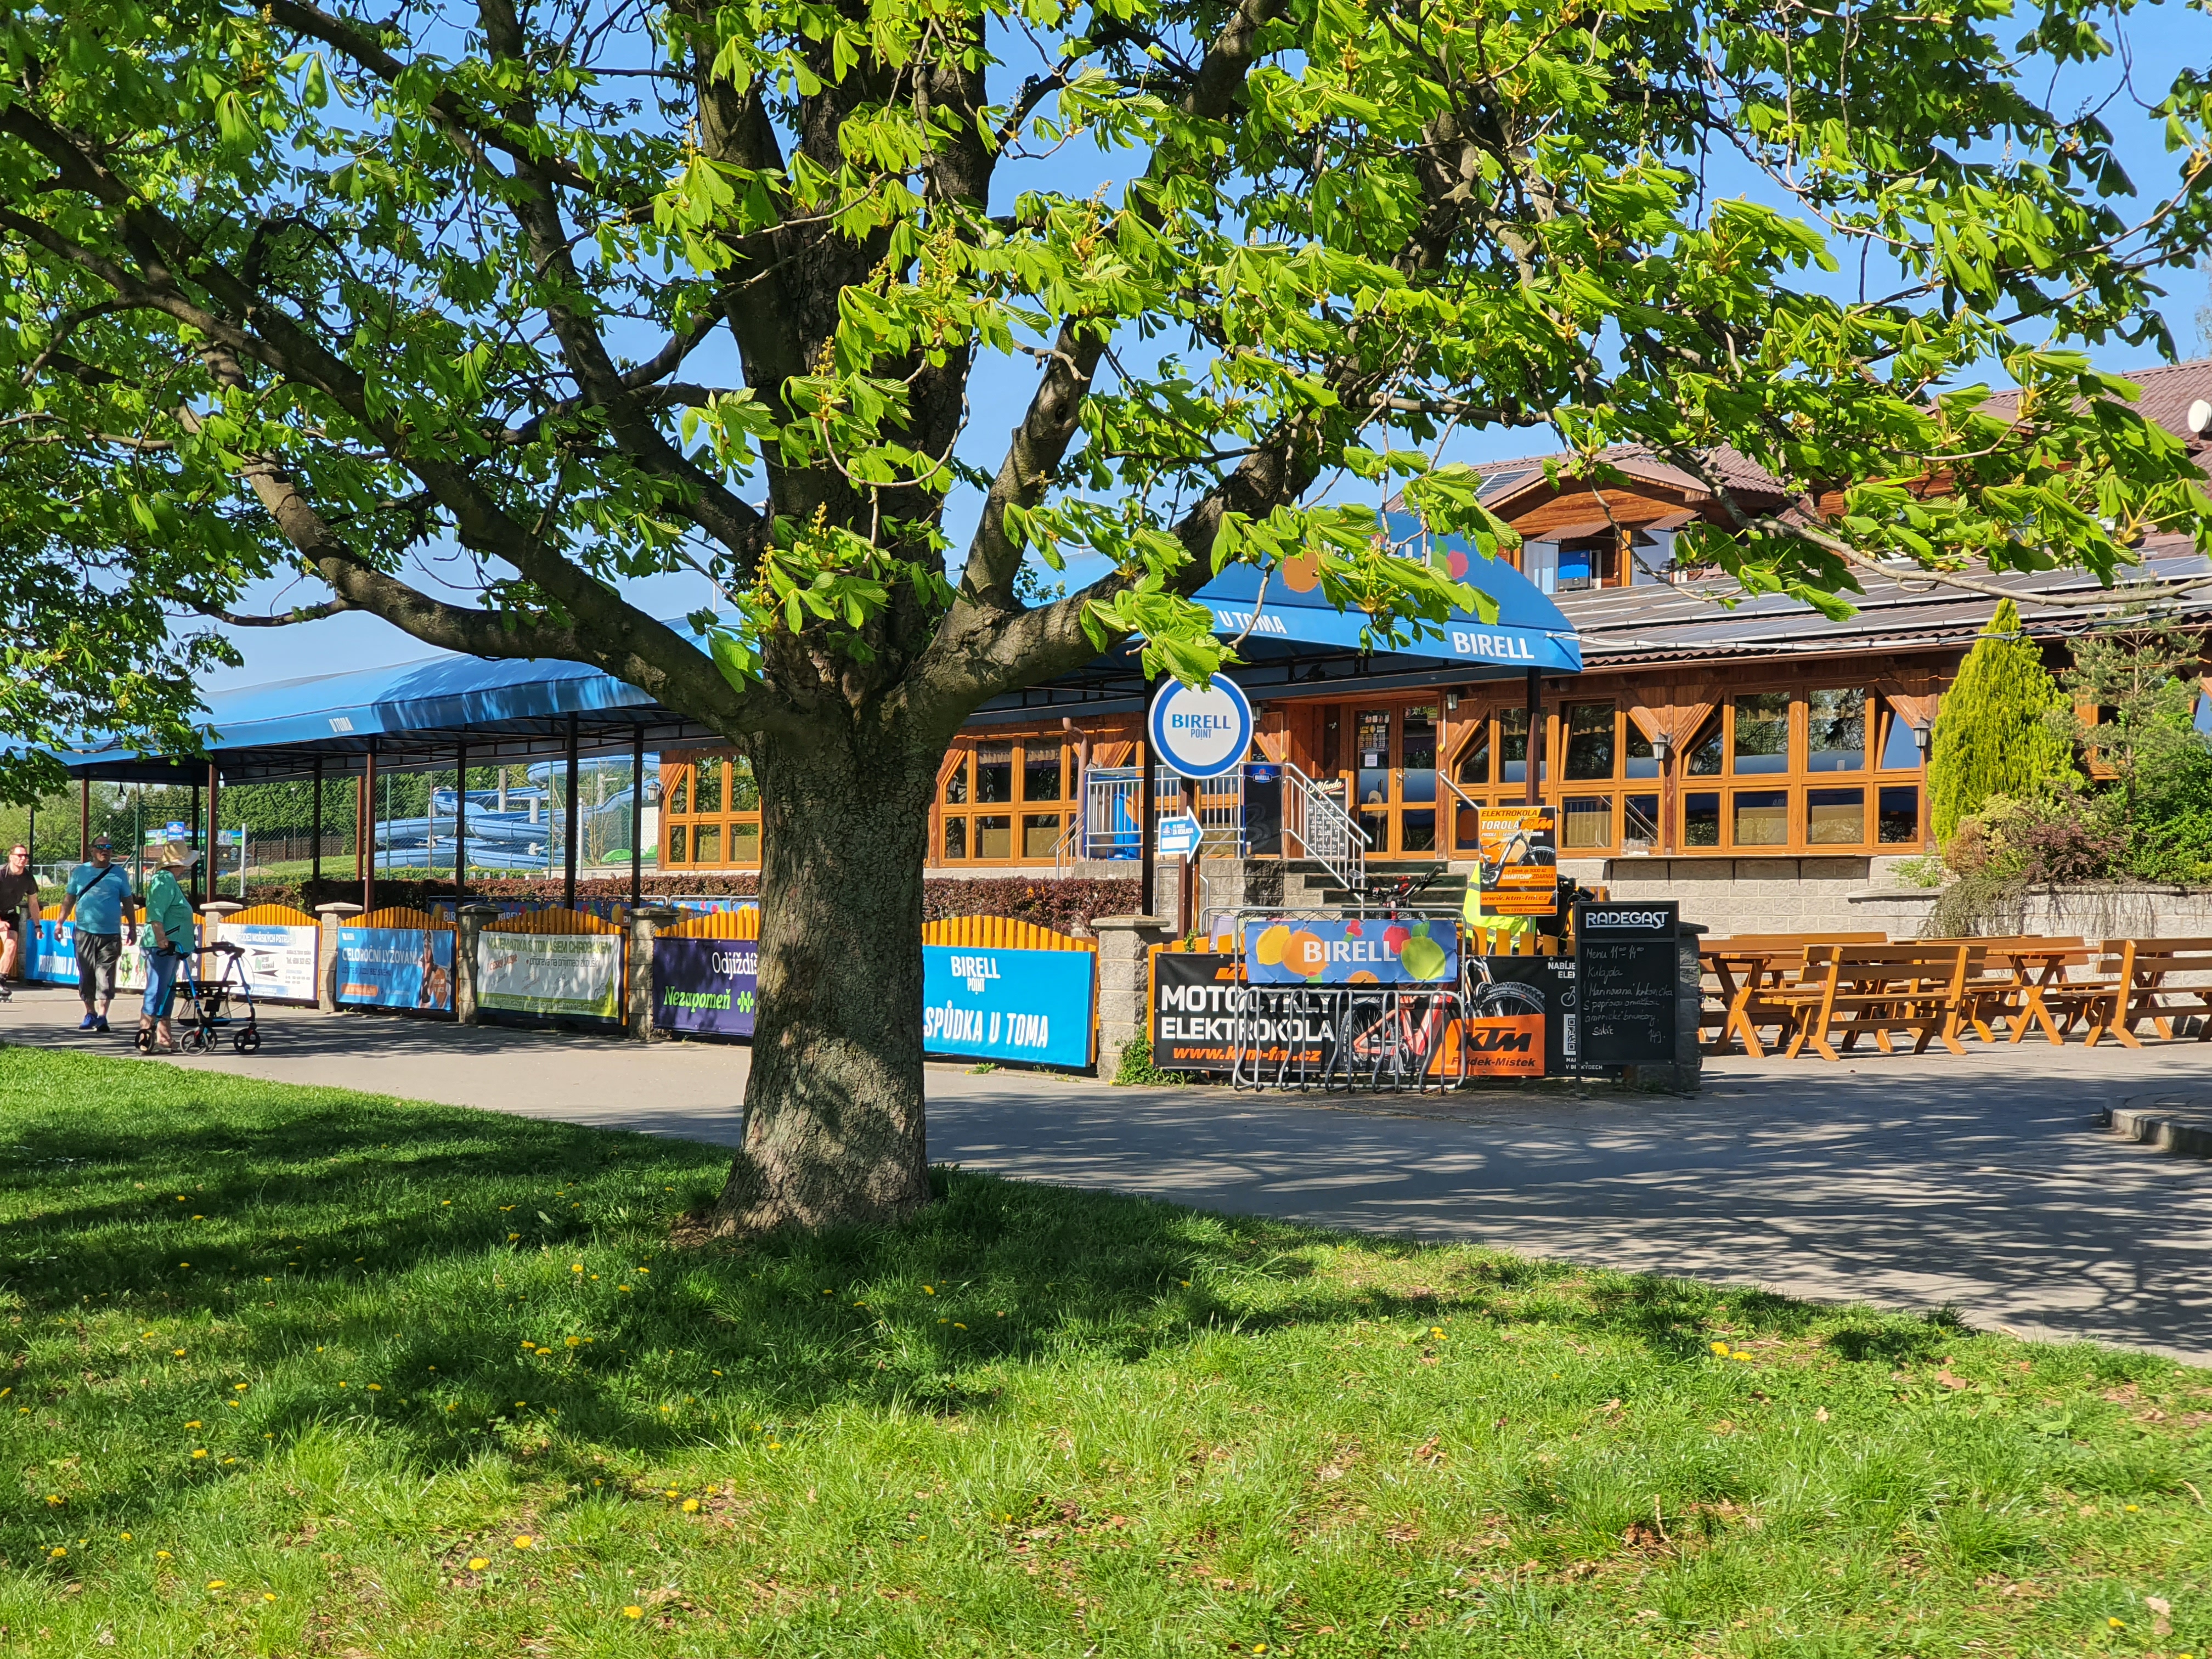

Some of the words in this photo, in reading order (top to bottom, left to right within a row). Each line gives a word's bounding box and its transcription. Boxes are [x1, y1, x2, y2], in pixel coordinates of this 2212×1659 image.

[1217, 610, 1234, 628] U
[1232, 612, 1288, 634] TOMA
[1452, 631, 1535, 659] BIRELL
[1172, 714, 1232, 729] BIRELL
[1190, 729, 1212, 740] POINT
[1481, 820, 1519, 830] TOROLA
[1520, 817, 1554, 830] KTM
[1586, 911, 1669, 929] RADEGAST
[342, 945, 381, 962] CELOROČNÍ
[382, 946, 417, 964] LYŽOVÁNÍ
[1304, 941, 1397, 962] BIRELL
[1586, 948, 1607, 959] Menu
[950, 956, 1001, 979] BIRELL
[1548, 960, 1576, 970] NABÍJE
[967, 977, 985, 995] POINT
[663, 986, 731, 1013] Nezapomeň
[924, 1000, 983, 1042] SPŮDKA
[989, 1012, 1001, 1043] U
[1006, 1013, 1048, 1048] TOMA
[1161, 1017, 1335, 1041] ELEKTROKOLA
[1455, 1027, 1532, 1052] KTM
[1173, 1046, 1322, 1062] www.ktm-fm.cz
